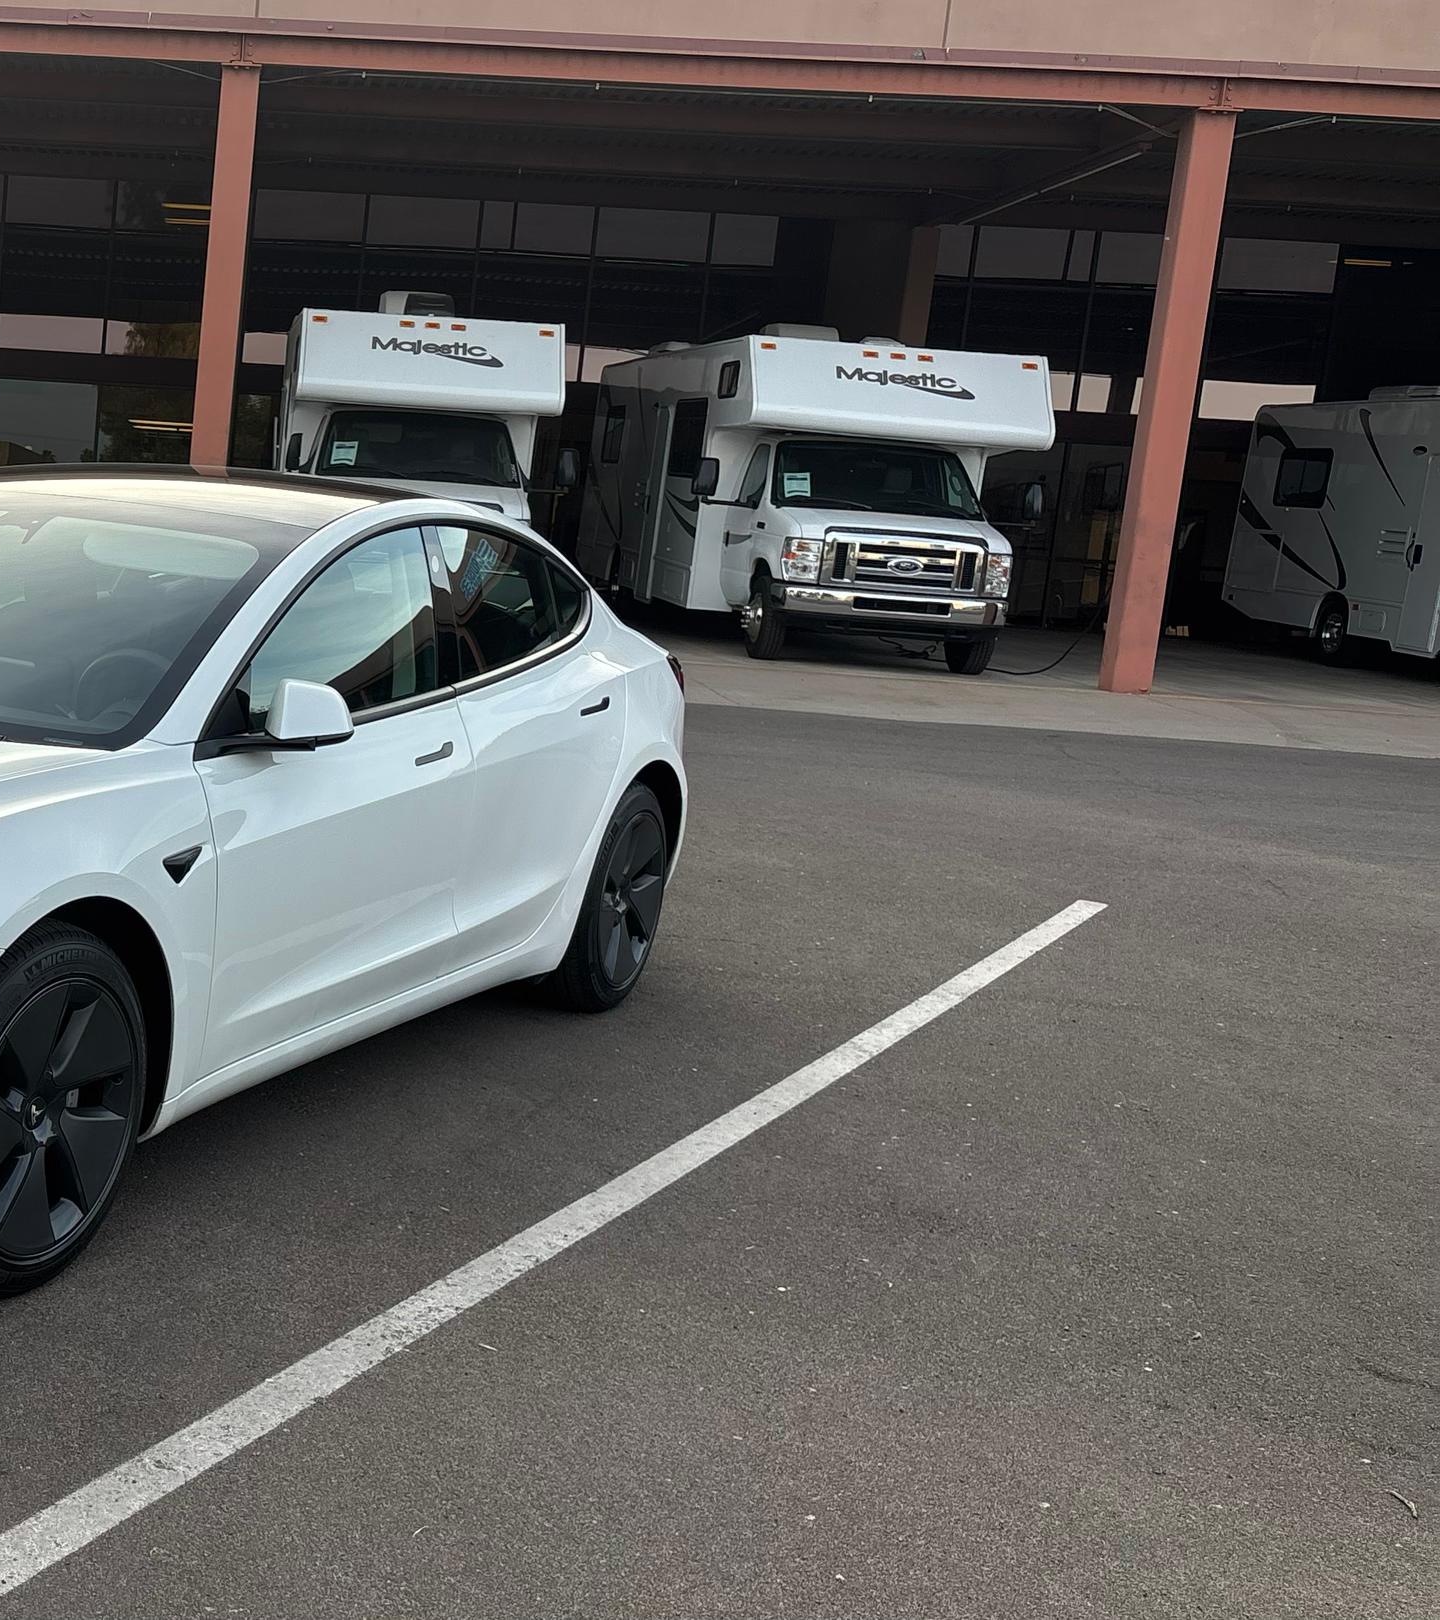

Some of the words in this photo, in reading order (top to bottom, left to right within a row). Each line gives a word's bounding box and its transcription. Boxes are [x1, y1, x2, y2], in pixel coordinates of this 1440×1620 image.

[371, 336, 488, 357] Majestic
[836, 366, 957, 388] Majestic
[41, 949, 101, 970] MICHELIN
